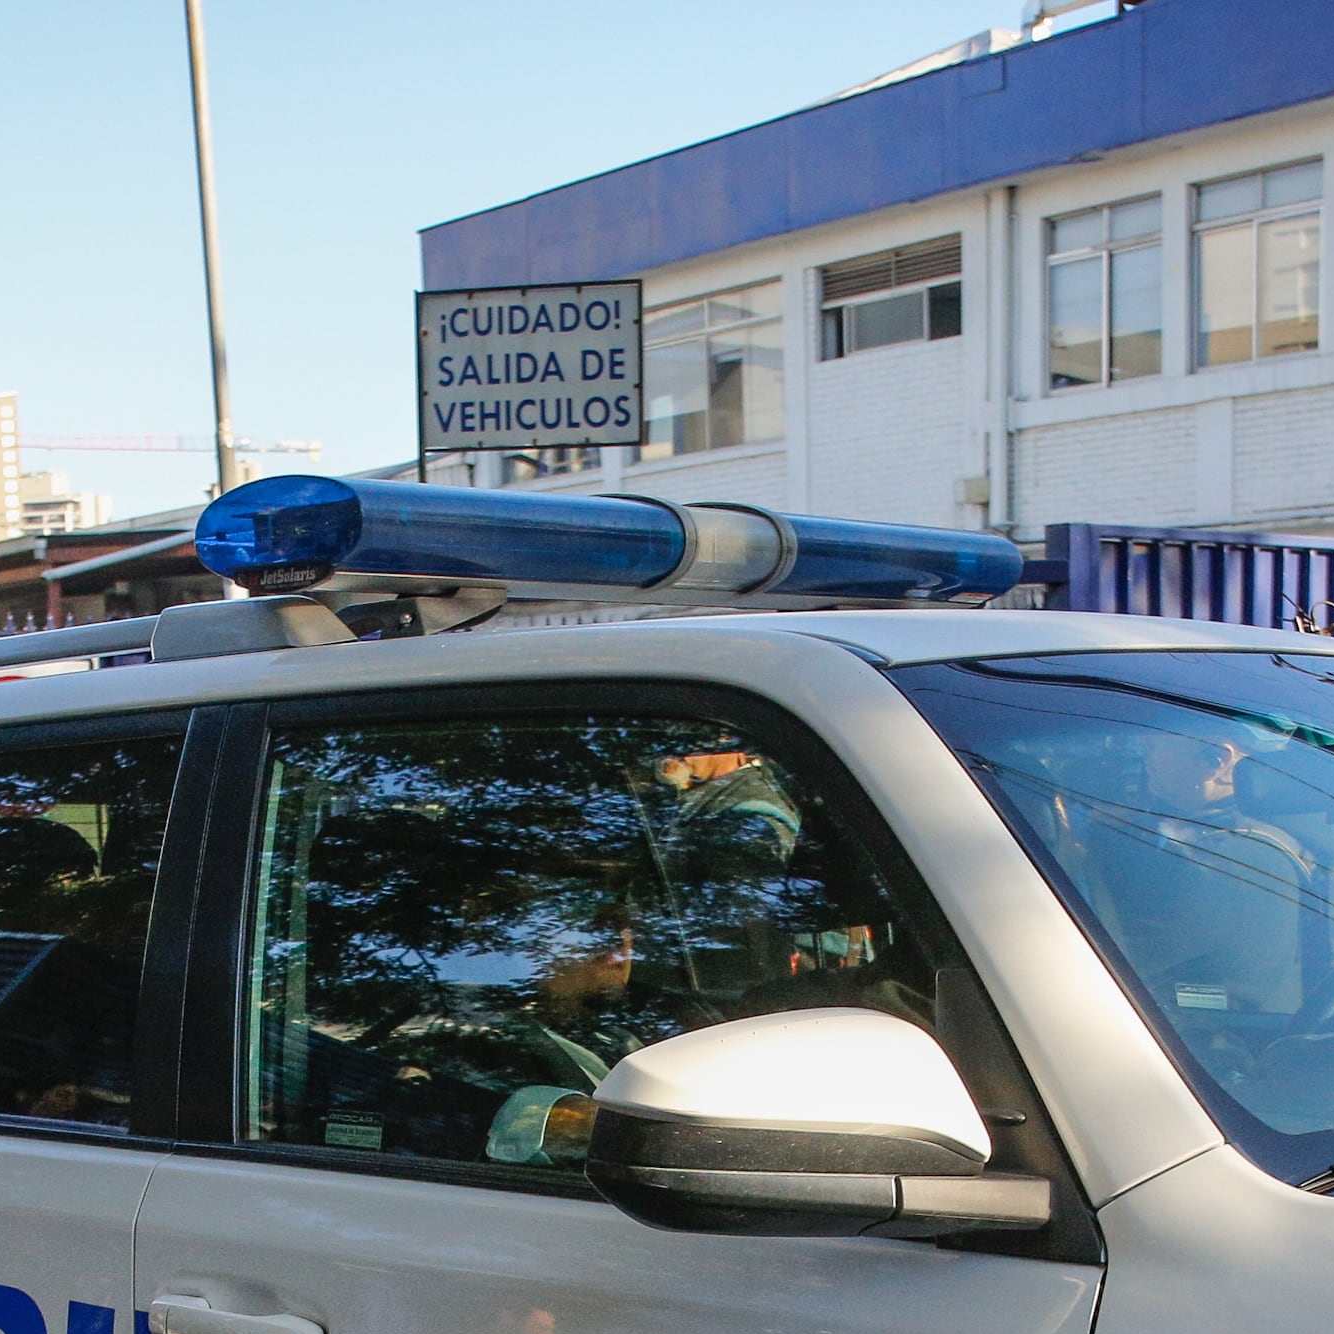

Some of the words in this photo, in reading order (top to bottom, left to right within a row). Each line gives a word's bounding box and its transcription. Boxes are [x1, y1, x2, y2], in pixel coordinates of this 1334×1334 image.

[440, 300, 620, 343] ¡CUIDADO!
[438, 351, 565, 387] SALIDA
[581, 348, 625, 381] DE
[433, 395, 631, 433] VEHICULOS
[260, 567, 316, 585] JetSolaris
